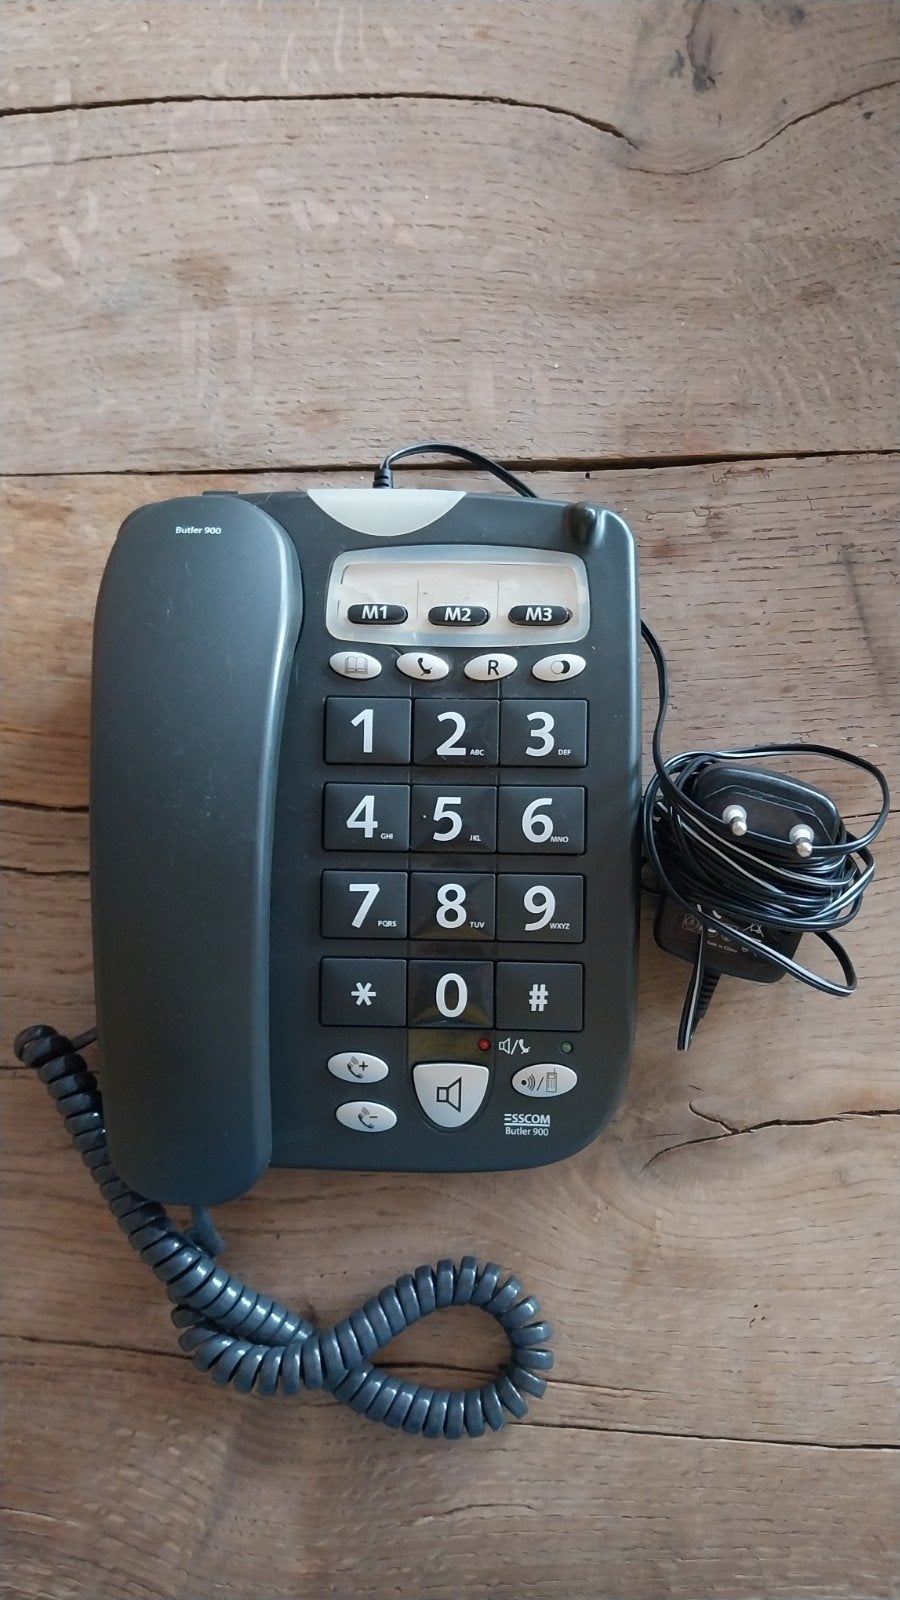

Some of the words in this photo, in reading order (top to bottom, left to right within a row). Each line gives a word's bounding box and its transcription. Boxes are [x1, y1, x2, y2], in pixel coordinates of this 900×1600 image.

[175, 526, 203, 535] Butler
[204, 526, 222, 535] 900
[361, 604, 388, 620] M1
[444, 607, 472, 622] M2
[525, 607, 553, 622] M3
[488, 659, 500, 676] R
[350, 708, 374, 753] 1
[436, 711, 467, 756] 2
[525, 711, 555, 757] 3
[469, 748, 485, 757] ABC
[557, 748, 572, 757] DEF
[346, 795, 378, 839] 4
[433, 796, 463, 842] 5
[521, 797, 554, 843] 6
[380, 832, 394, 840] GHI
[469, 834, 482, 843] JKL
[550, 835, 569, 844] MNO
[349, 883, 380, 929] 7
[435, 883, 467, 929] 8
[523, 885, 556, 931] 9
[377, 920, 397, 928] PQRS
[469, 921, 485, 929] TUV
[549, 922, 570, 931] WXYZ
[435, 972, 468, 1018] 0
[528, 983, 549, 1012] #
[503, 1113, 551, 1124] ESSCOM
[504, 1126, 532, 1136] Butler
[533, 1126, 550, 1136] 900
